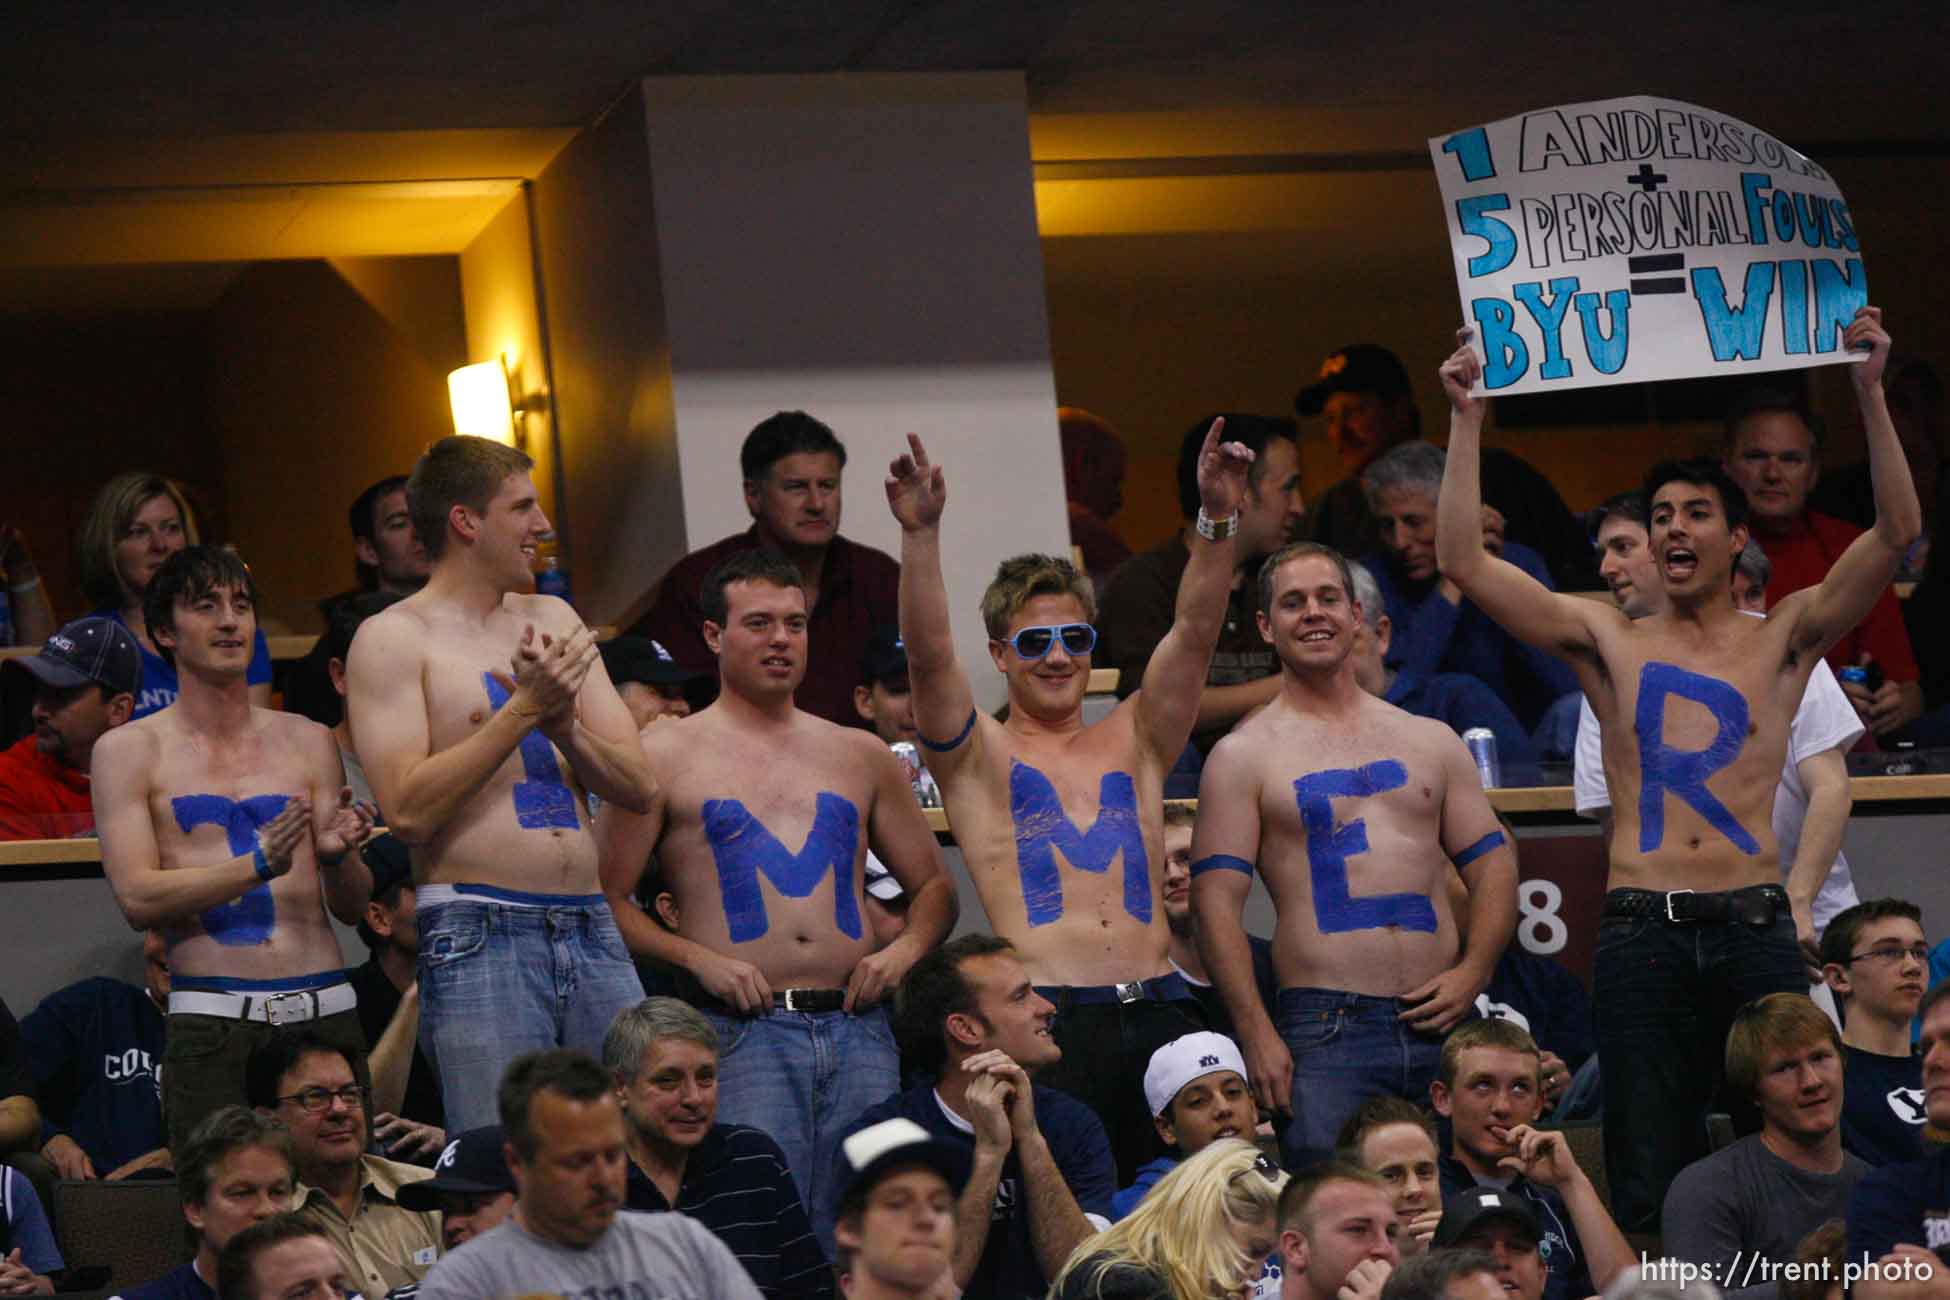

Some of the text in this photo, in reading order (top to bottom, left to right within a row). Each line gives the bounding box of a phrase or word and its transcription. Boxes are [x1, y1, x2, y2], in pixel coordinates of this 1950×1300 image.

[1442, 127, 1497, 183] 1
[1456, 172, 1860, 279] 5 PERSONAL FOULS
[1471, 277, 1632, 390] BYU
[1690, 258, 1869, 362] WIN
[702, 790, 864, 945] M
[1009, 756, 1153, 929] M
[1293, 758, 1439, 935] E
[1635, 661, 1762, 857] R
[1517, 879, 1568, 955] 8
